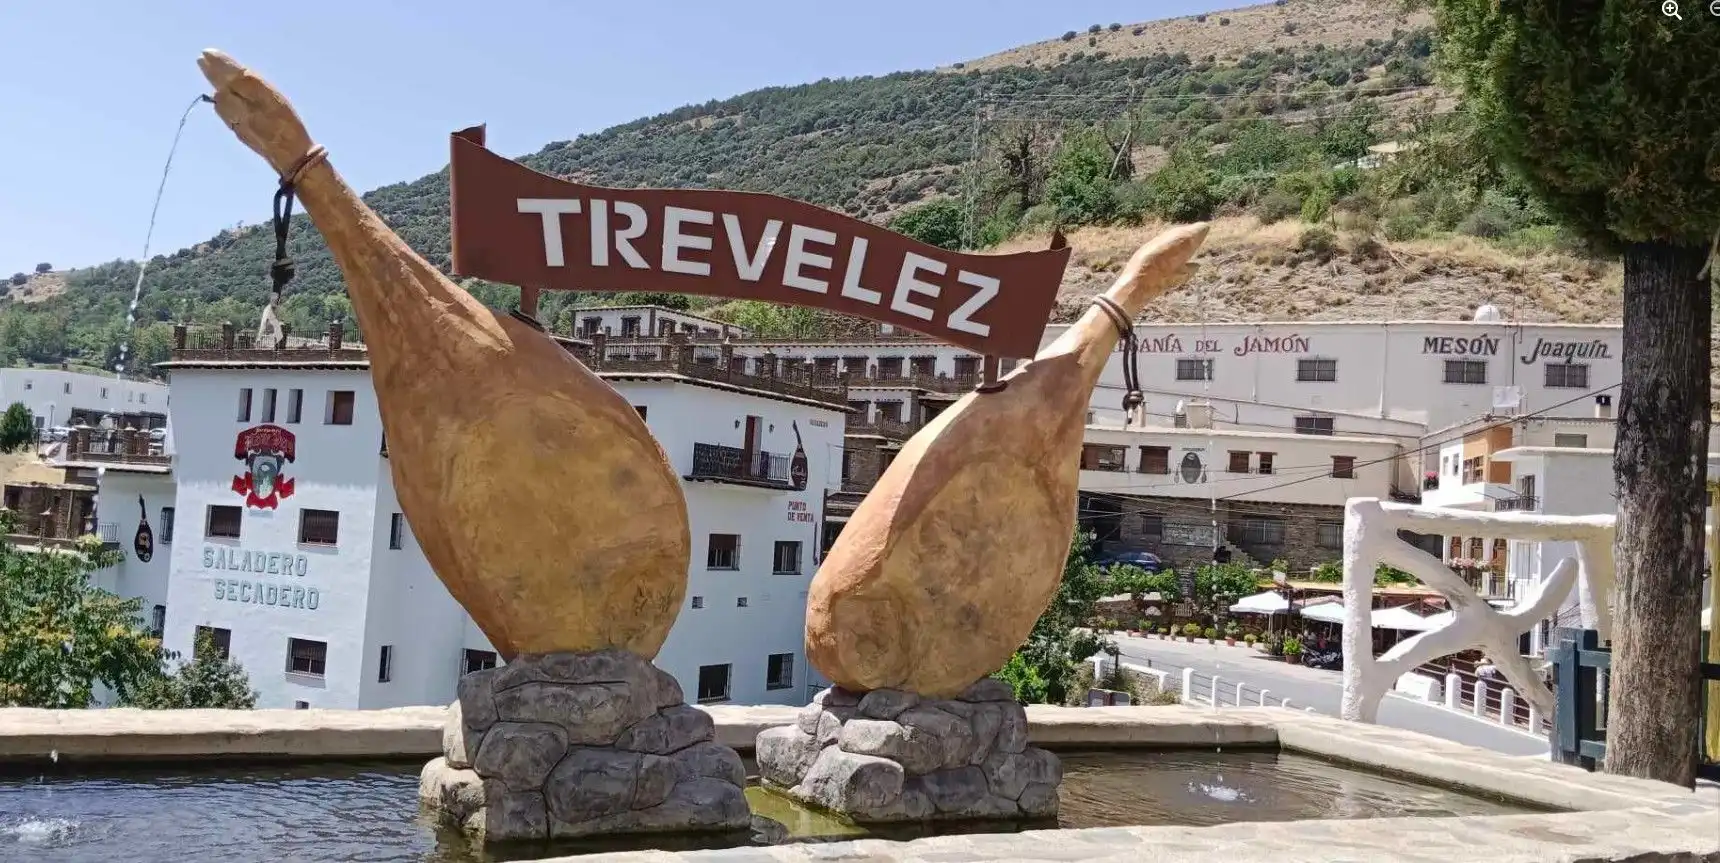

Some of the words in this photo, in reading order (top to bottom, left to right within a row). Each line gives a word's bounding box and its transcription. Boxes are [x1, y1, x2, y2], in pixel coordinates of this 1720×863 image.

[517, 198, 1000, 337] TREVELEZ
[1195, 339, 1223, 352] DEL
[1234, 333, 1310, 356] JAMÓN
[1422, 333, 1501, 356] MESÓN
[1521, 337, 1612, 364] Joaquín
[787, 512, 795, 521] DE
[797, 512, 815, 523] VENTA
[788, 500, 807, 511] PUNTO
[203, 546, 308, 576] SALADERO
[214, 579, 320, 610] SECADERO
